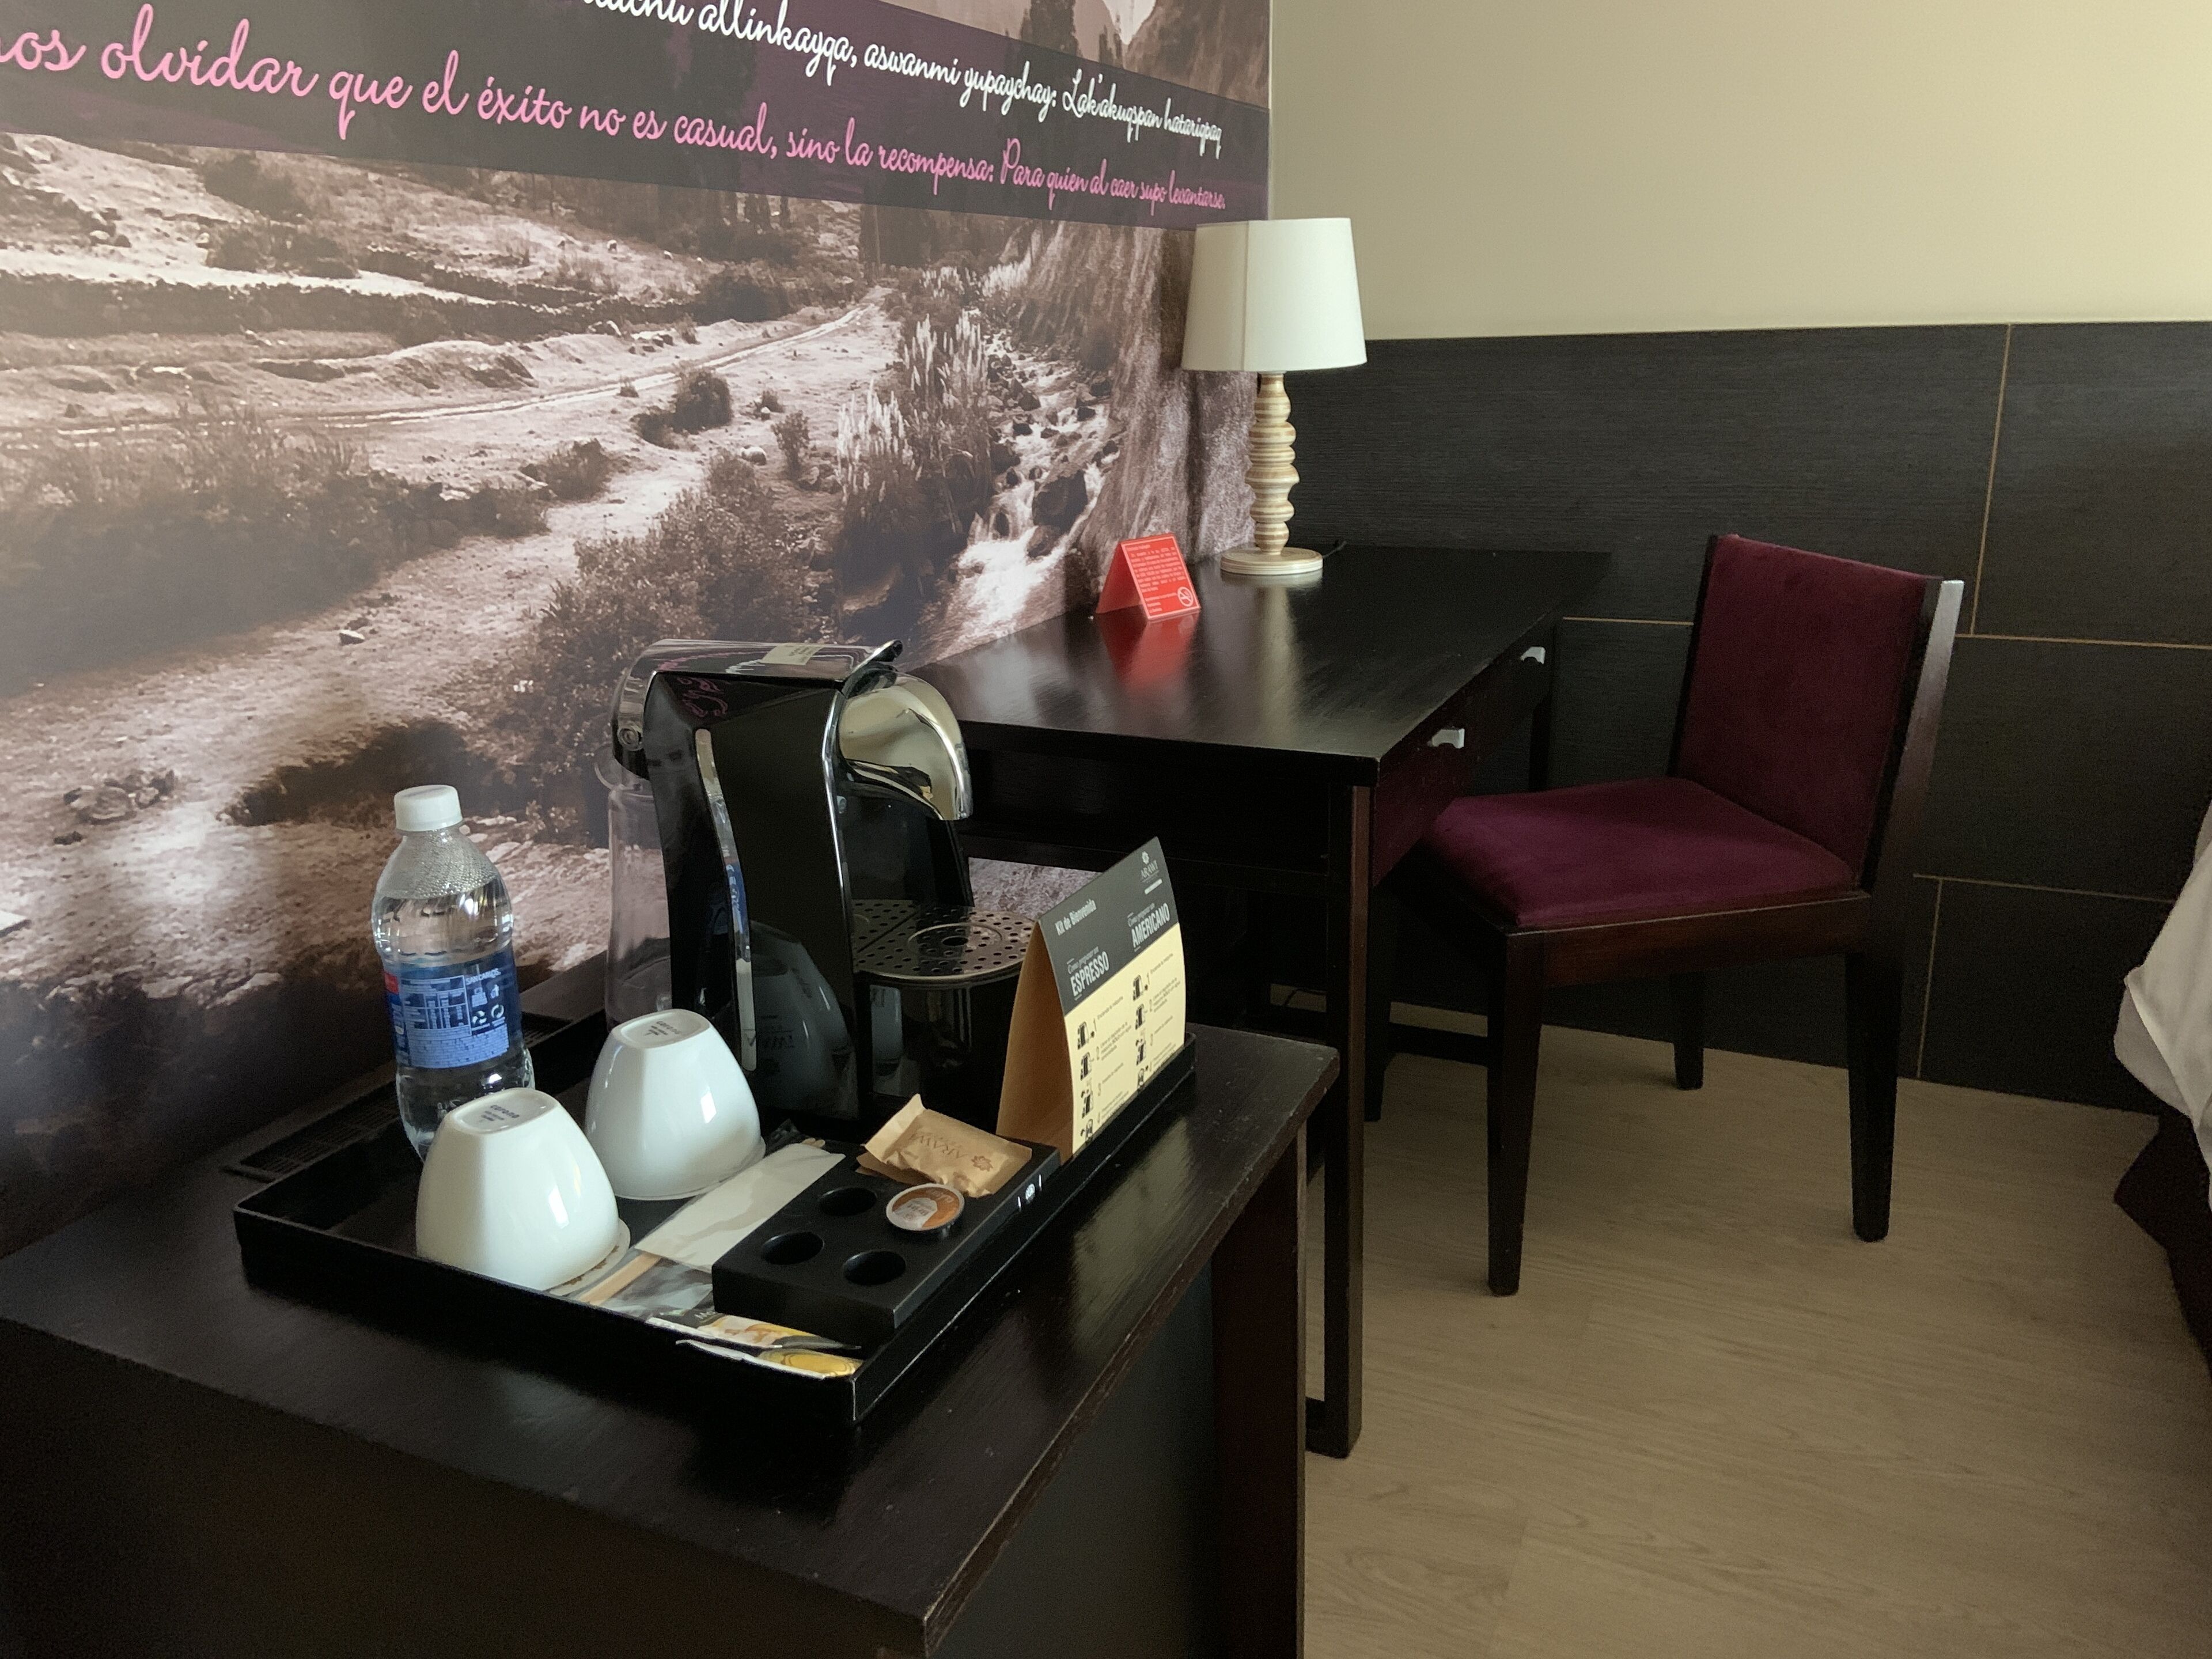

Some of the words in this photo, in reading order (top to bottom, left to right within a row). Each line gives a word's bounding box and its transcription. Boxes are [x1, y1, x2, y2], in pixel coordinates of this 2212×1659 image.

[698, 0, 858, 86] allinkayqa,
[863, 44, 962, 85] aswanmi
[960, 60, 1058, 123] yupaychay:
[0, 29, 86, 71] os
[101, 3, 320, 97] olvidar
[328, 70, 413, 140] que
[422, 50, 469, 115] el
[477, 75, 573, 128] éxito
[579, 104, 626, 136] no
[632, 110, 667, 140] es
[673, 101, 778, 159] casual,
[785, 128, 842, 164] sino
[844, 117, 874, 166] la
[878, 145, 994, 195] recompensa:
[999, 138, 1044, 187] Para
[1046, 167, 1089, 210] quien
[1089, 158, 1110, 194] al
[1109, 178, 1139, 199] caer
[1139, 181, 1168, 216] supo
[1168, 169, 1226, 210] levantarse.
[1055, 921, 1066, 936] Kit
[1063, 915, 1072, 930] de
[1069, 899, 1097, 926] Bienvenida
[1131, 903, 1171, 948] AMERICANO
[1070, 950, 1109, 997] ESPRESSO
